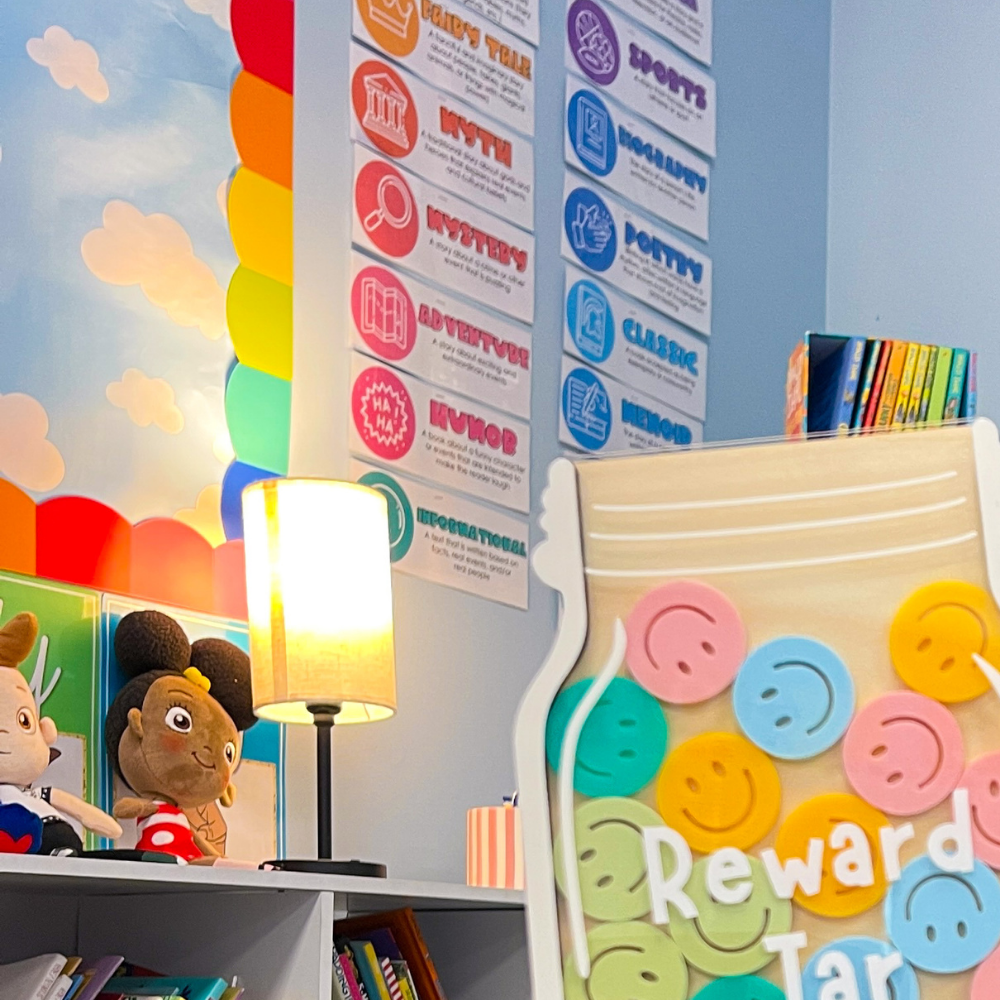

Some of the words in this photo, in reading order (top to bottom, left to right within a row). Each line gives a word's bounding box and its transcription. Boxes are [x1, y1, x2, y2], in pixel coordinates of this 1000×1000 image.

[485, 33, 532, 81] TALE
[629, 42, 706, 110] SPORTS
[440, 105, 512, 170] MYTH
[618, 124, 706, 195] BIOGRAPHY
[427, 204, 528, 273] MYSTERY
[625, 221, 703, 284] POETRY
[419, 303, 529, 370] ADVENTURE
[623, 318, 698, 376] CLASSIC
[373, 396, 391, 414] HA
[376, 414, 394, 433] HA
[430, 398, 518, 457] HUMOR
[621, 398, 692, 445] MEMOIR
[417, 506, 526, 558] INFORMATIONAL
[643, 788, 974, 924] Reward
